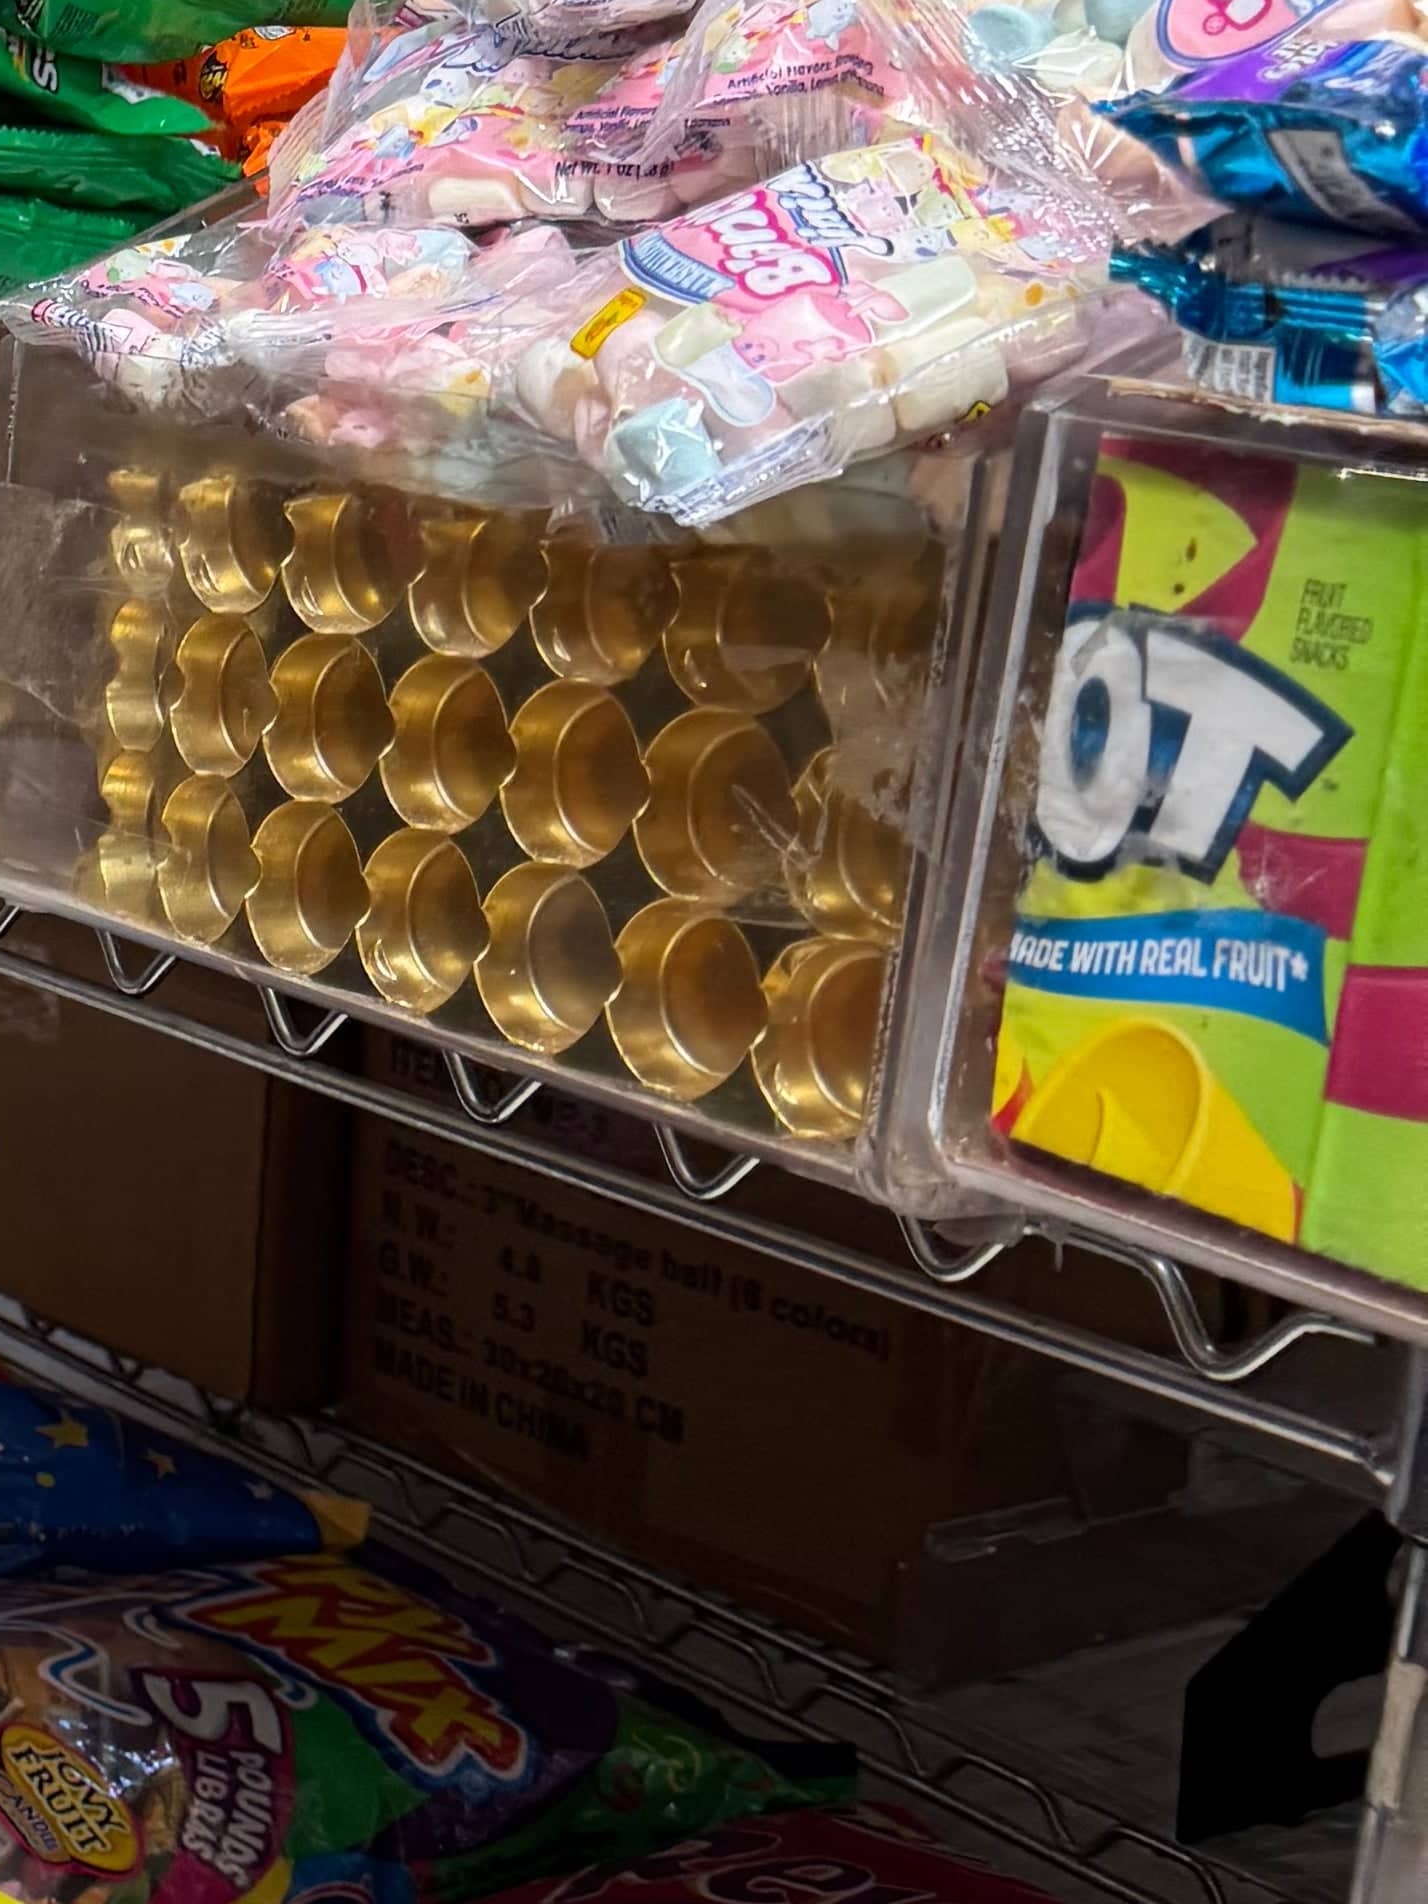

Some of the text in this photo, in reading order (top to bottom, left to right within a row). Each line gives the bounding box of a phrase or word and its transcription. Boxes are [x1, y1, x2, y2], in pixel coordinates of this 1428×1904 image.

[554, 161, 578, 178] Net
[1302, 578, 1350, 610] FRUIT
[1291, 640, 1353, 669] SNACKS
[1296, 609, 1375, 646] FLAVORED
[1070, 937, 1136, 978] WITH
[1141, 938, 1207, 980] REAL
[585, 1271, 658, 1327] KGS
[577, 1317, 650, 1379] KGS
[374, 1334, 590, 1462] MADE IN CHINA
[147, 1673, 285, 1754] 5
[10, 1744, 114, 1854] FRUIT
[45, 1739, 128, 1835] JOVY
[181, 1749, 227, 1864] LIBRAS
[218, 1751, 279, 1886] POUNDS
